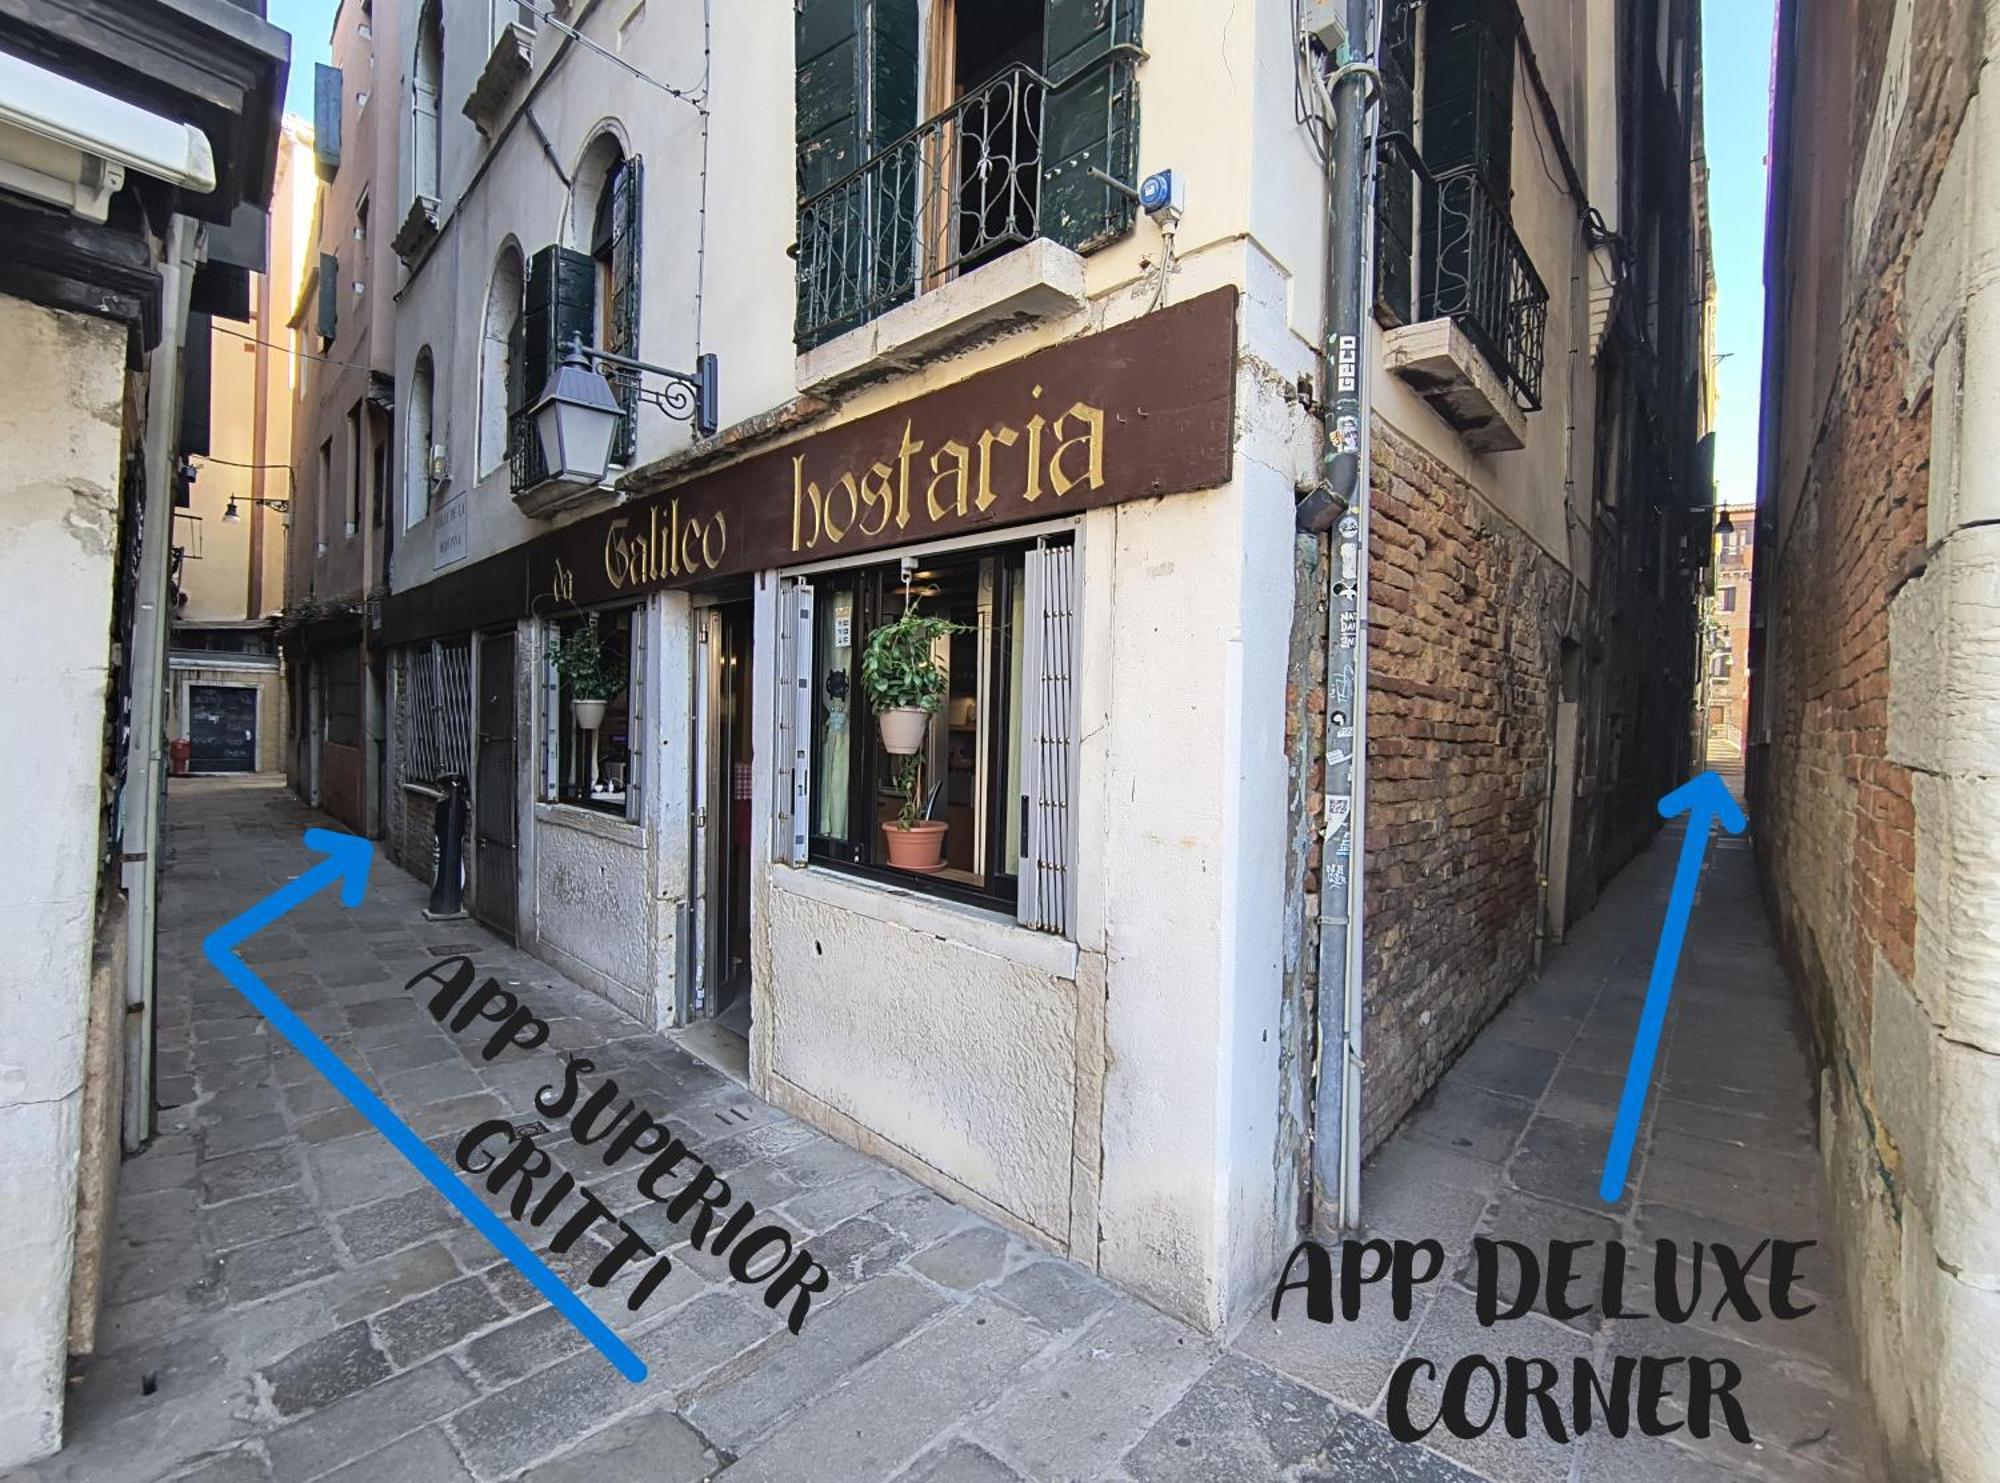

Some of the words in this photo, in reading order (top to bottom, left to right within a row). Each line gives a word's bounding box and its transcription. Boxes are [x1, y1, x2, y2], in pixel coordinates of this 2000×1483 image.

[552, 557, 574, 603] da
[604, 497, 727, 590] Galileo
[790, 384, 1105, 552] hostaria
